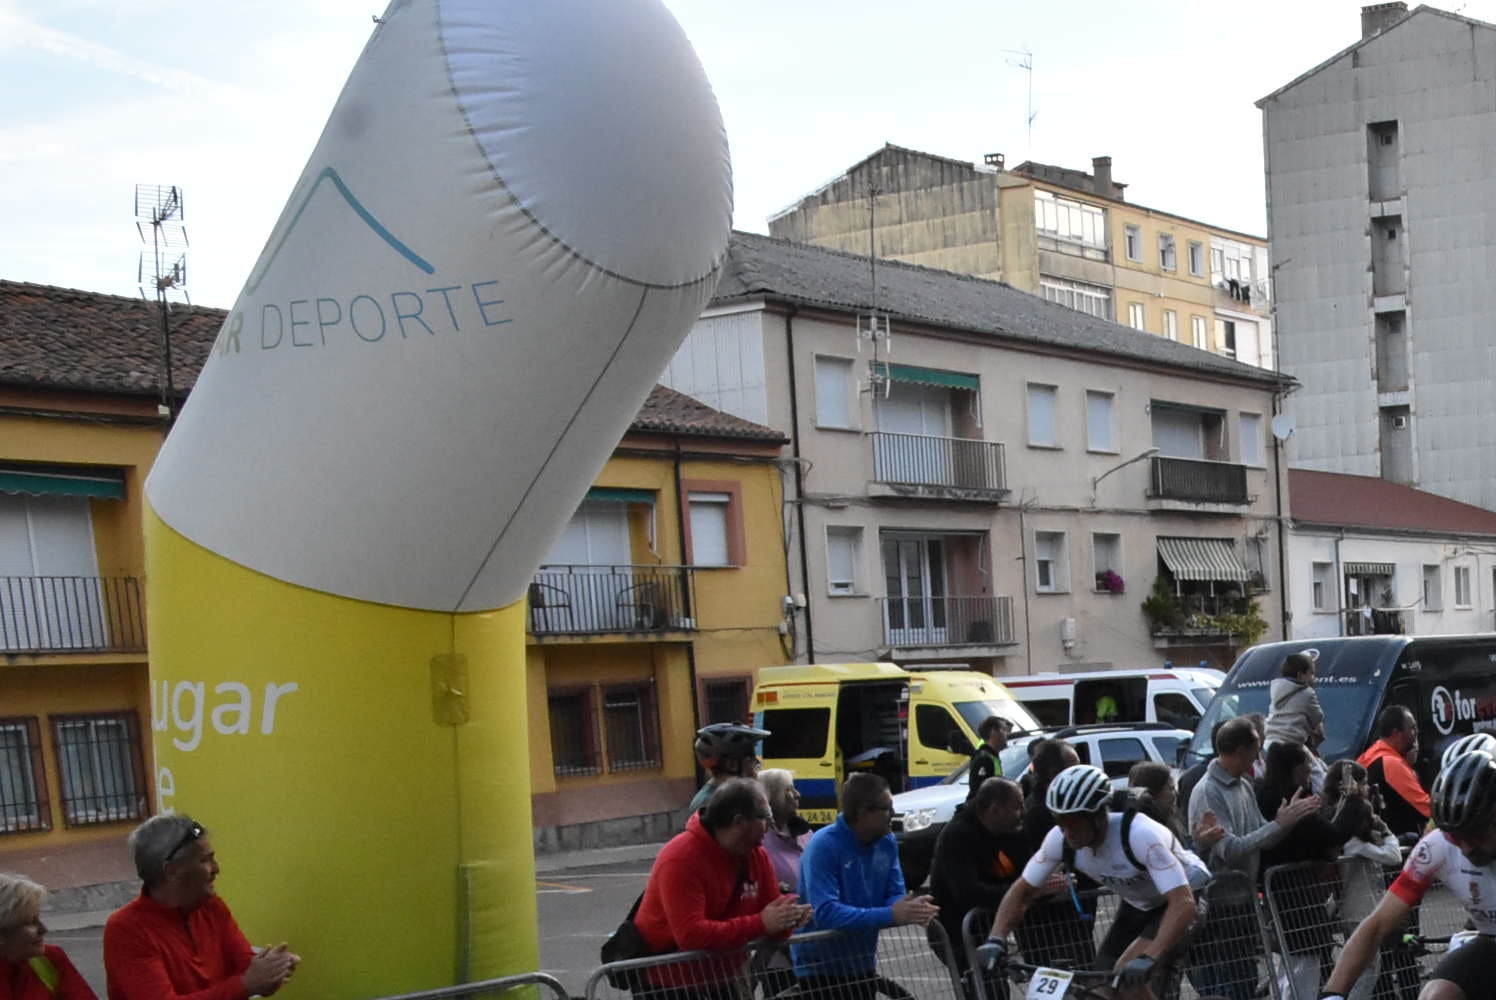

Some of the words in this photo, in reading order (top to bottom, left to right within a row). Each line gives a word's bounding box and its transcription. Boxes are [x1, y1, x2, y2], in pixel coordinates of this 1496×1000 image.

[260, 280, 514, 350] DEPORTE
[152, 680, 299, 752] ugar
[1036, 977, 1059, 995] 29
